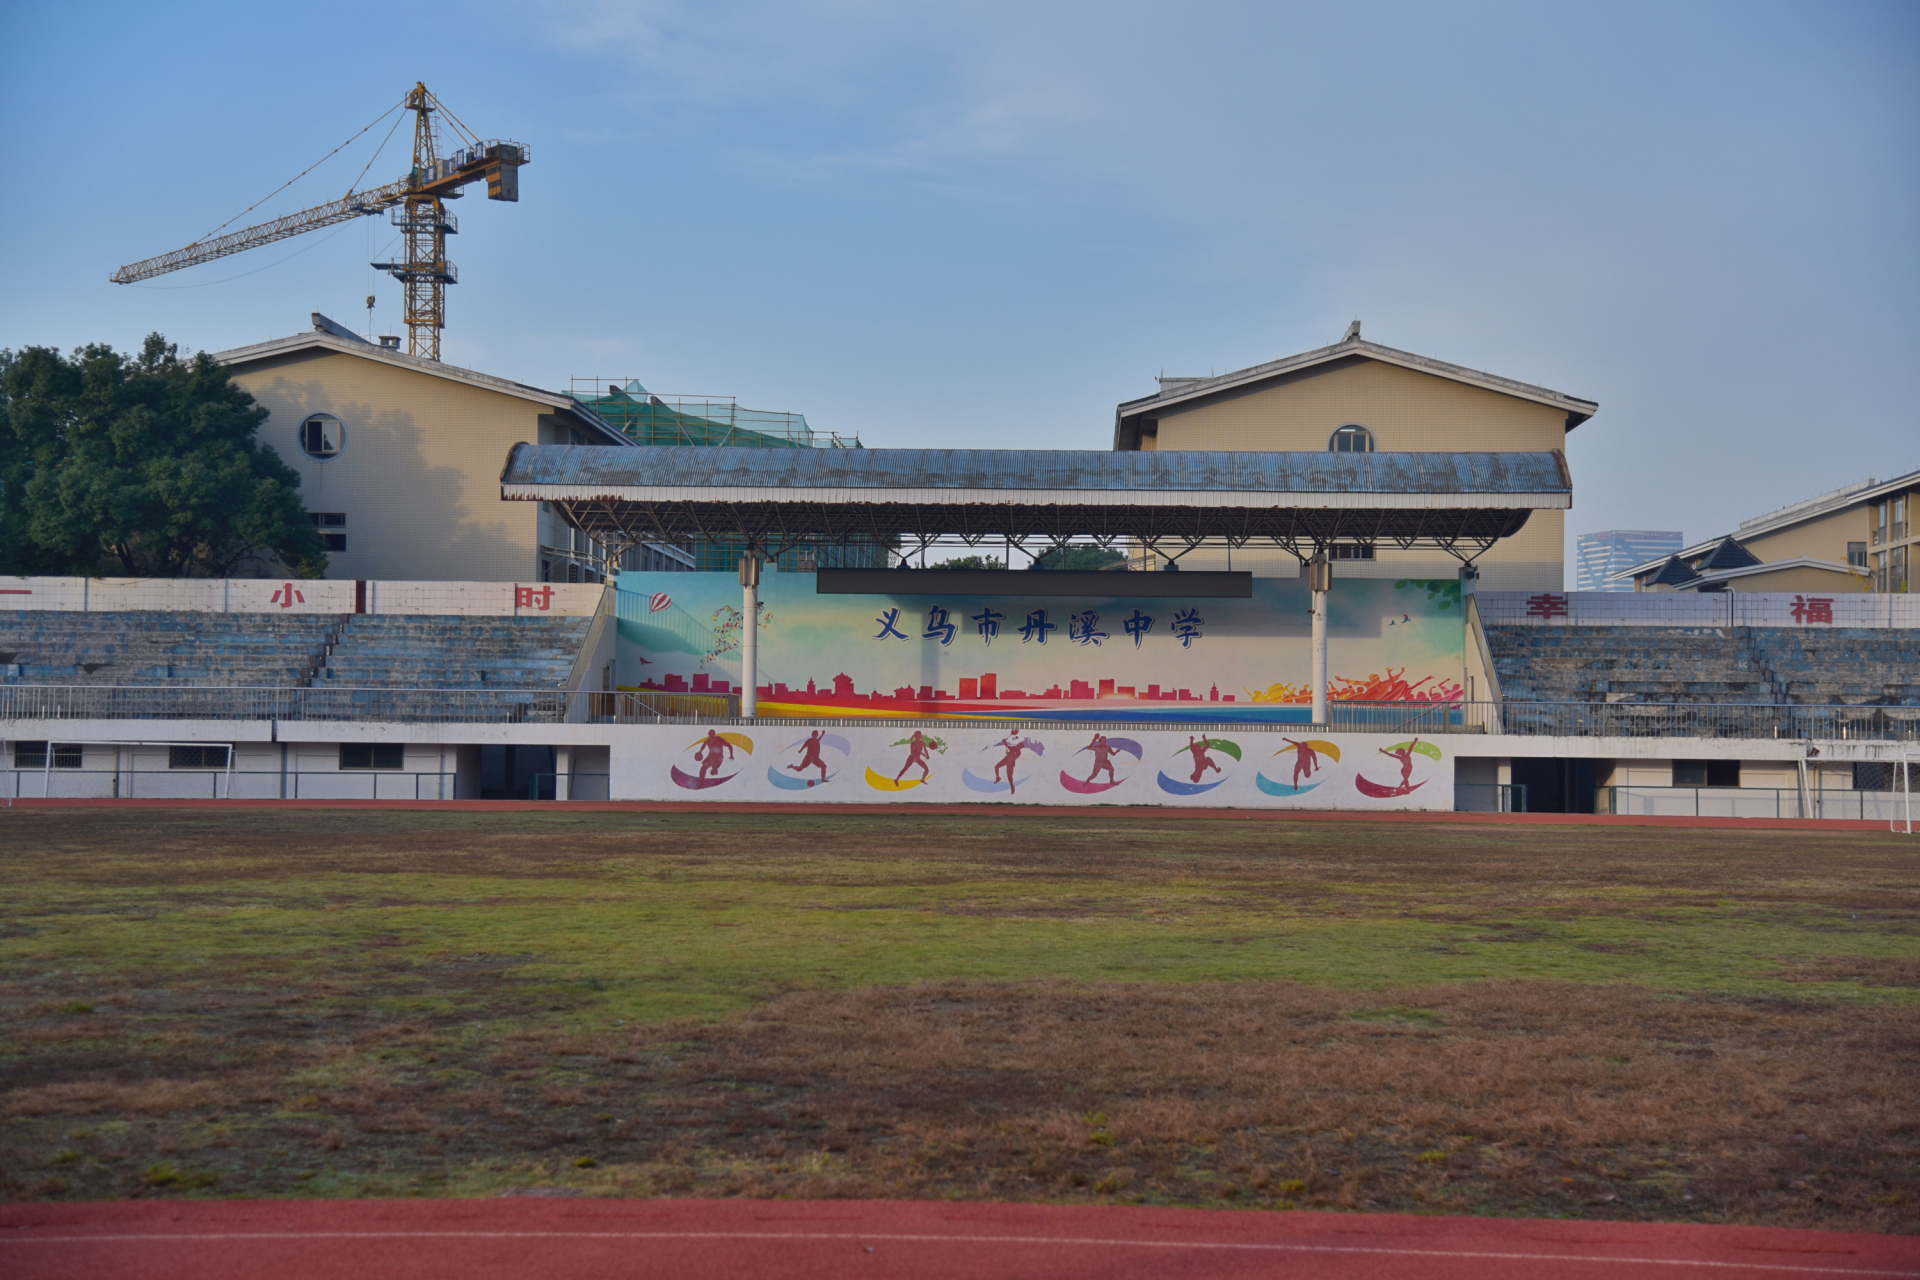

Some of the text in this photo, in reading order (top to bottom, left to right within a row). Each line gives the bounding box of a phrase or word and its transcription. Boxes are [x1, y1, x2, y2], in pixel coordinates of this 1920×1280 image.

[270, 582, 305, 607] 小
[515, 585, 555, 610] 时
[1526, 593, 1834, 624] 幸 福
[872, 604, 1204, 649] 义乌市丹溪中学
